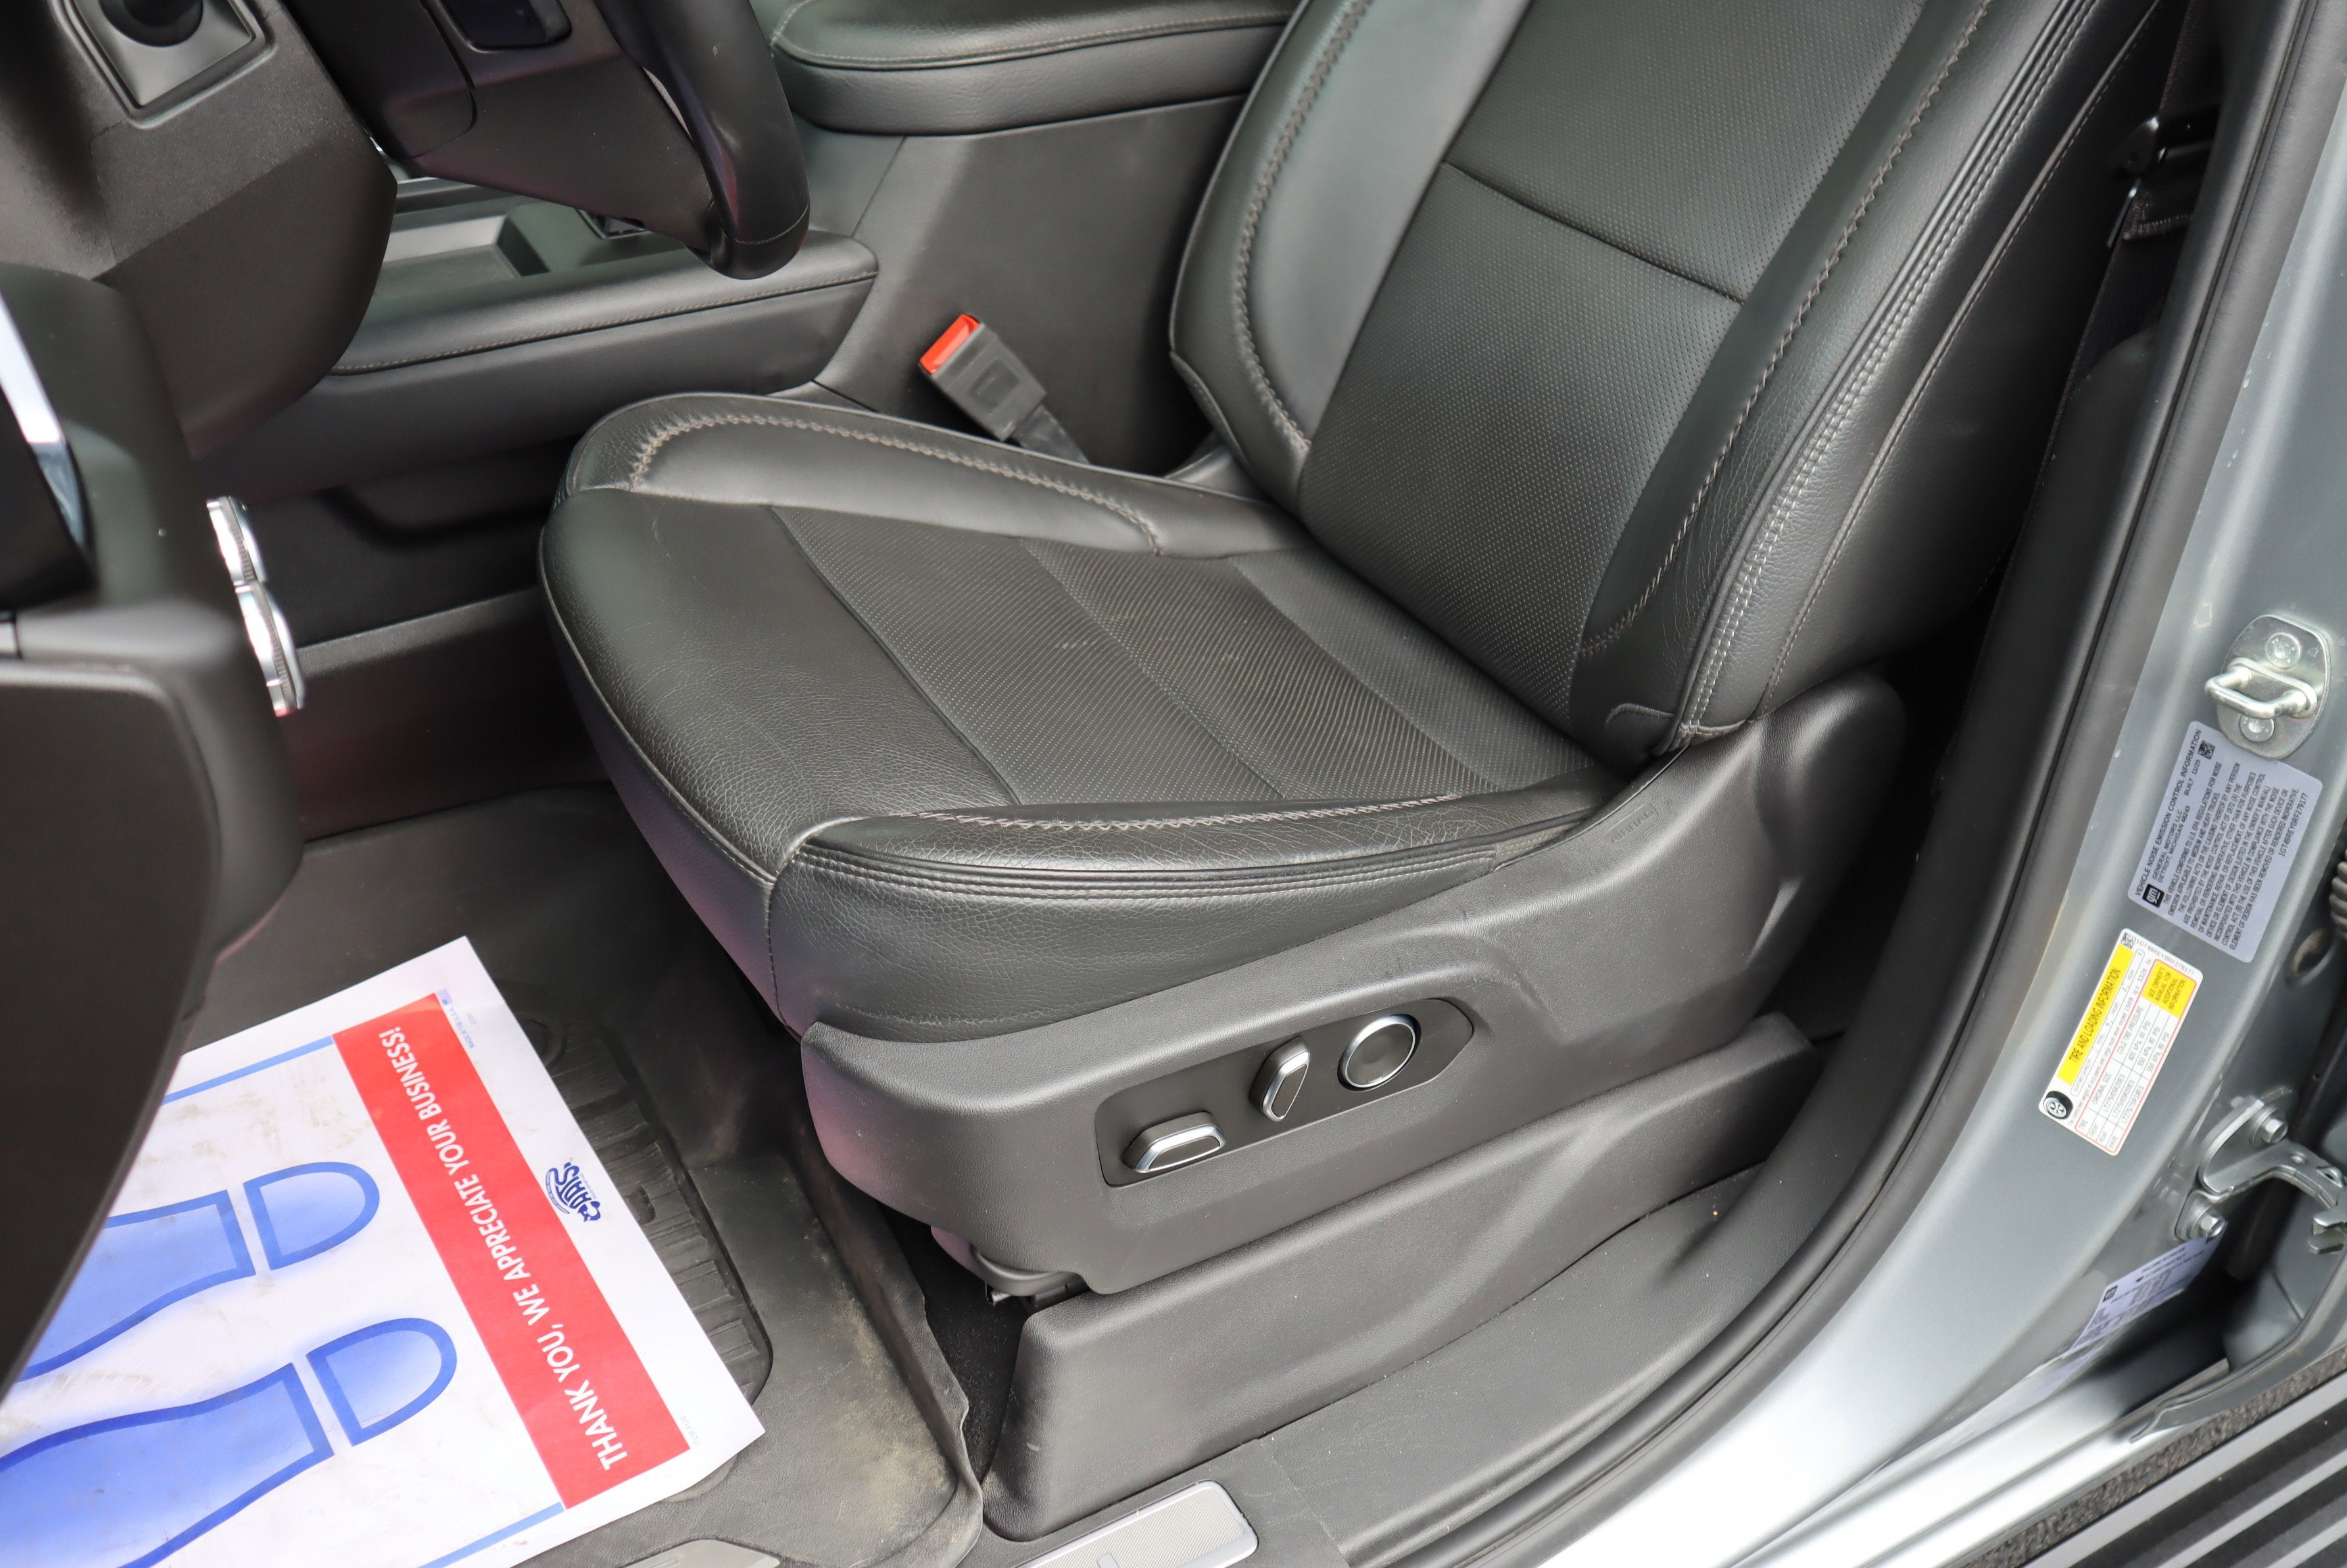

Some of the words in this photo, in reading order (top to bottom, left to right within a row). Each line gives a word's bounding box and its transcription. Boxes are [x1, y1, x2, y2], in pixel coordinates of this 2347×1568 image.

[2183, 777, 2194, 796] BUILT
[2191, 758, 2201, 775] 11/23
[2210, 760, 2222, 778] NOISE
[2227, 761, 2241, 784] PERSON
[2206, 776, 2217, 788] FOR
[2223, 782, 2233, 794] ANY
[2233, 782, 2242, 794] THE
[2240, 770, 2256, 799] PURPOSES
[2251, 771, 2266, 796] CONTROL
[2221, 793, 2229, 802] BY
[2230, 792, 2240, 802] (A)
[2256, 784, 2273, 810] MANUAL)
[2268, 785, 2281, 804] NOISE
[2280, 787, 2290, 798] OR
[2135, 866, 2150, 897] VEHICLE
[2146, 845, 2159, 868] NOISE
[2154, 811, 2171, 846] EMISSION
[2167, 777, 2184, 812] CONTROL
[2179, 728, 2202, 778] INFORMATION
[2194, 786, 2212, 821] REGULATIONS
[2212, 800, 2226, 825] THEREOF
[2236, 797, 2246, 810] FOR
[2245, 795, 2256, 812] NOISE
[2264, 802, 2274, 813] THE
[2273, 796, 2286, 816] DEVICE
[2200, 811, 2212, 829] HEAVY
[2222, 812, 2231, 822] OF
[2231, 808, 2242, 823] THAN
[2241, 810, 2250, 823] ANY
[2248, 807, 2262, 831] OWNER'S
[2259, 811, 2270, 826] WITH
[2267, 814, 2279, 830] SUCH
[1608, 807, 1655, 844] AIRBAG
[2191, 819, 2200, 831] EPA
[2196, 827, 2206, 839] AND
[2218, 820, 2228, 832] ACT
[2224, 822, 2237, 840] OTHER
[2237, 820, 2246, 830] OF
[2270, 820, 2287, 848] RENDERED
[2168, 823, 2184, 856] MICHIGAN
[2184, 839, 2193, 848] TO
[2204, 823, 2217, 846] CAUSING
[2209, 830, 2224, 855] CONTROL
[2244, 829, 2253, 841] THE
[2246, 825, 2265, 858] COMPLIANCE
[2261, 828, 2273, 846] AFTER
[2152, 850, 2167, 881] GENERAL
[2162, 821, 2177, 850] MOTORS
[2173, 808, 2182, 823] LLC
[2189, 837, 2202, 858] MEDIUM
[2200, 843, 2209, 856] THE
[2267, 846, 2276, 856] OR
[2174, 846, 2189, 875] CONFORMS
[2186, 856, 2195, 866] TO
[2197, 854, 2206, 863] OR
[2204, 852, 2215, 870] NOISE
[2233, 845, 2248, 866] (LISTED
[2252, 844, 2267, 866] VEHICLE
[2192, 862, 2202, 876] ACTS
[2200, 868, 2209, 879] THE
[2221, 864, 2229, 873] OR
[2227, 864, 2240, 884] DESIGN
[2236, 861, 2250, 883] VEHICLE
[2248, 864, 2258, 877] THIS
[2257, 854, 2273, 879] REMOVED
[2167, 873, 2180, 894] VEHICLE
[2176, 863, 2192, 894] APPLICABLE
[2197, 878, 2205, 887] BY
[2201, 870, 2218, 899] RENDERING
[2224, 882, 2232, 891] OF
[2231, 881, 2242, 894] THIS
[2245, 876, 2254, 885] OF
[2252, 877, 2263, 893] BEEN
[2146, 885, 2162, 906] gm
[2181, 875, 2198, 904] FOLLOWING
[2241, 883, 2251, 896] USE
[2248, 891, 2258, 904] HAS
[2162, 893, 2172, 906] THIS
[2167, 892, 2181, 916] EMISSION
[2178, 902, 2187, 914] THE
[2186, 885, 2202, 915] PROHIBITED
[2198, 897, 2207, 907] OR
[2215, 889, 2229, 913] ELEMENT
[2227, 892, 2237, 906] INTO
[2237, 893, 2246, 906] THE
[2189, 905, 2204, 929] REMOVAL
[2212, 911, 2221, 921] OR
[2234, 904, 2244, 913] (B)
[2240, 902, 2253, 922] DESIGN
[2182, 913, 2192, 925] ARE
[2205, 918, 2217, 938] DEVICE
[2212, 904, 2233, 942] INCORPORATED
[2237, 919, 2246, 929] OF
[2197, 925, 2206, 933] OF
[2221, 922, 2235, 946] CONTROL
[2228, 927, 2243, 951] ELEMENT
[2094, 966, 2121, 1010] INFORMATION
[2146, 987, 2156, 998] SEE
[2154, 981, 2167, 1002] MANUAL
[2162, 971, 2173, 982] FOR
[2161, 976, 2179, 1004] ADDITIONAL
[2167, 978, 2186, 1010] INFORMATION
[2081, 1006, 2102, 1037] LOADING
[2115, 1039, 2127, 1055] COLD
[2122, 1029, 2132, 1042] TIRE
[2127, 1004, 2144, 1031] PRESSURE
[2075, 1034, 2089, 1050] AND
[2068, 1047, 2083, 1064] TIRE
[377, 1023, 445, 1123] BUSINESS!
[2091, 1082, 2106, 1106] ORIGINAL
[2101, 1071, 2112, 1084] SIZE
[425, 1116, 471, 1176] YOUR
[453, 1171, 531, 1288] APPRECIATE
[512, 1281, 553, 1327] WE
[533, 1320, 587, 1383] YOU,
[562, 1378, 631, 1471] THANK
[687, 1429, 702, 1447] ITEM
